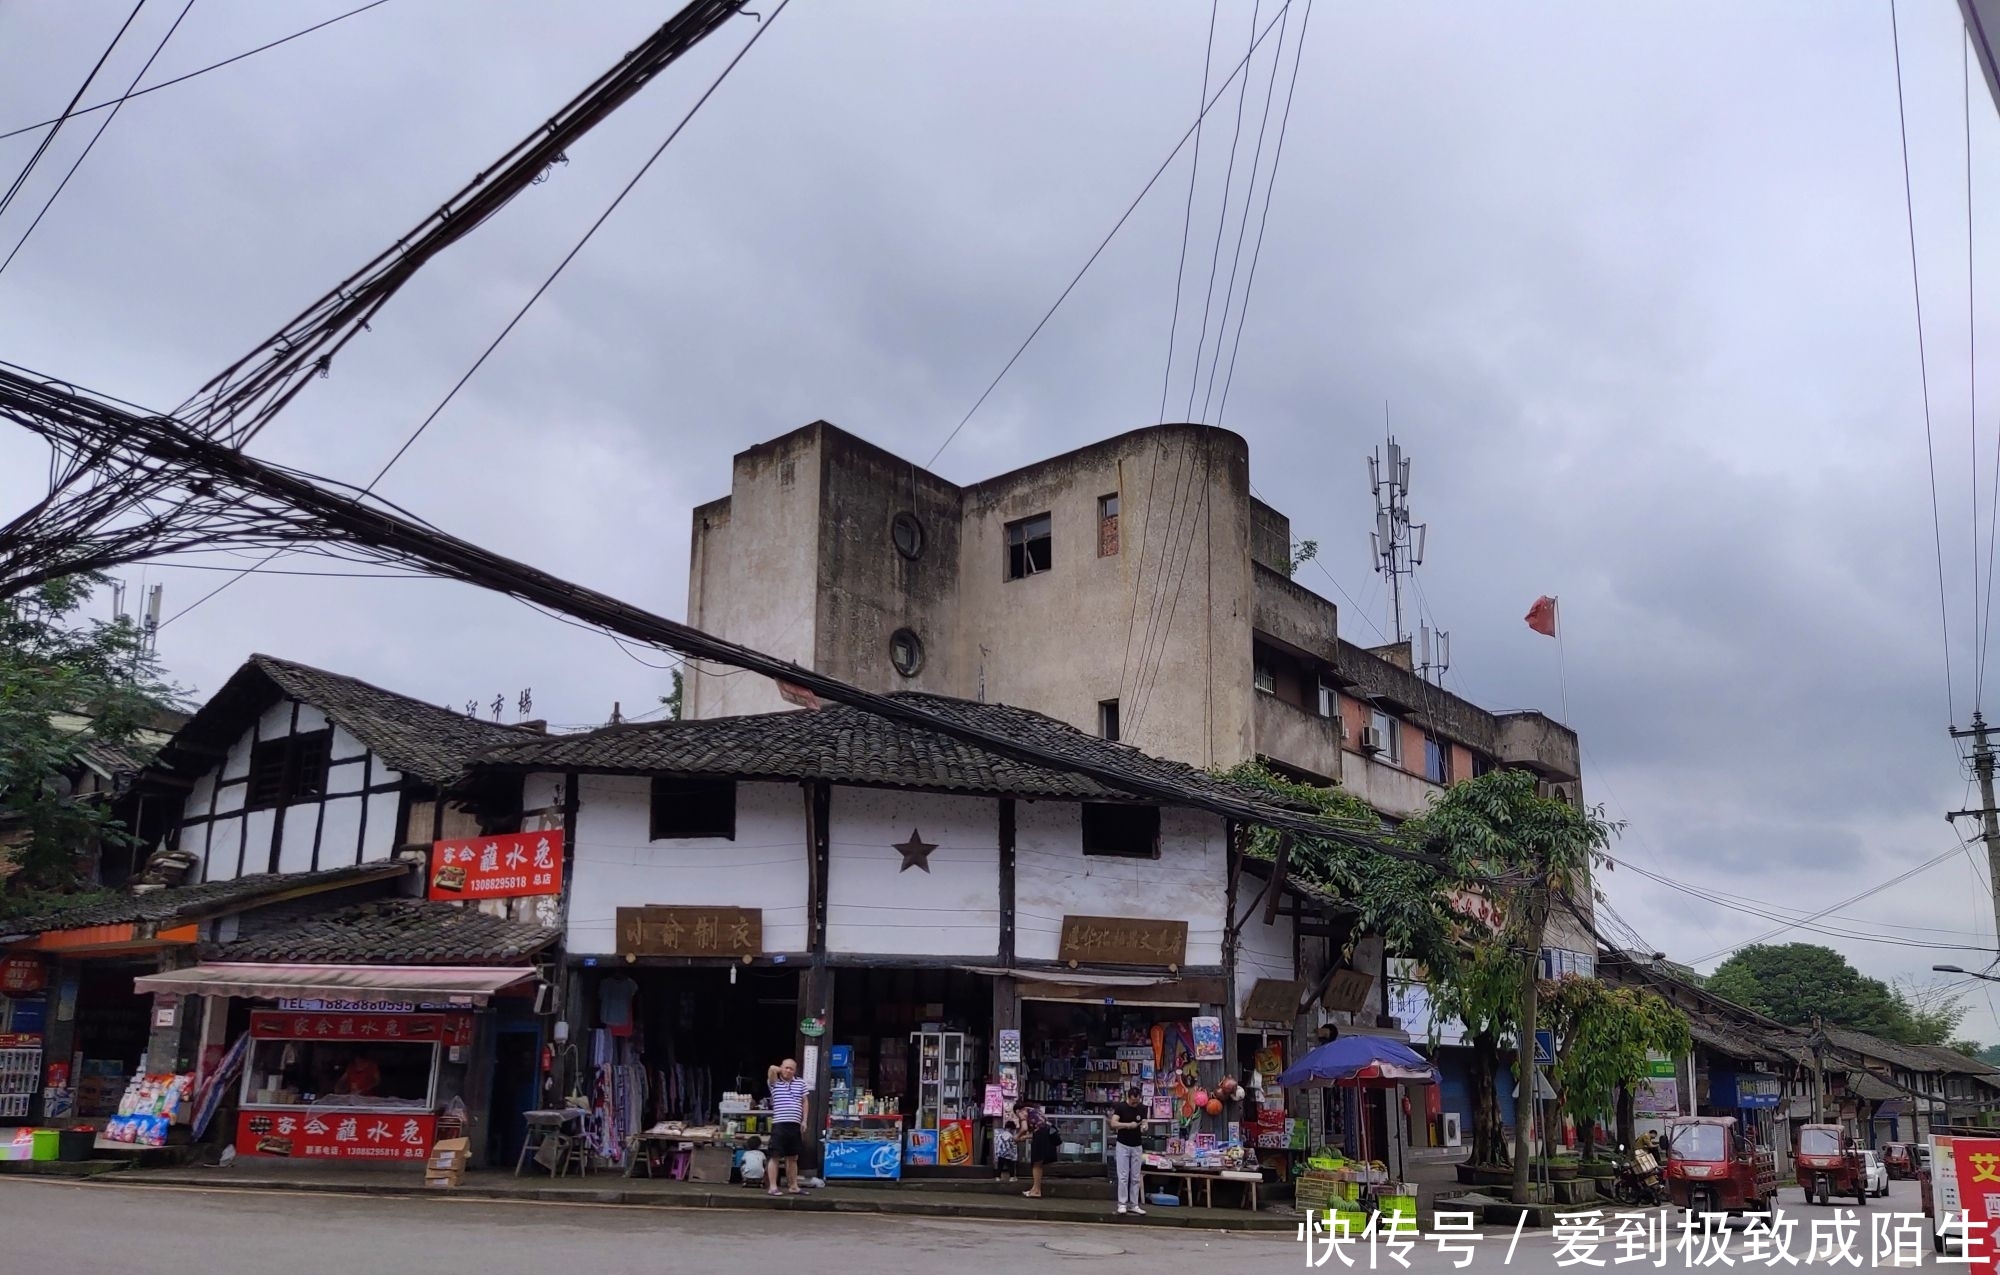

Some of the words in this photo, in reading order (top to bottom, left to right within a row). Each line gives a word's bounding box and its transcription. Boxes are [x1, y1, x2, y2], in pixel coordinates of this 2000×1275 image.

[471, 876, 527, 891] 13088295818
[533, 874, 551, 885] 总店
[403, 1148, 424, 1158] 总店
